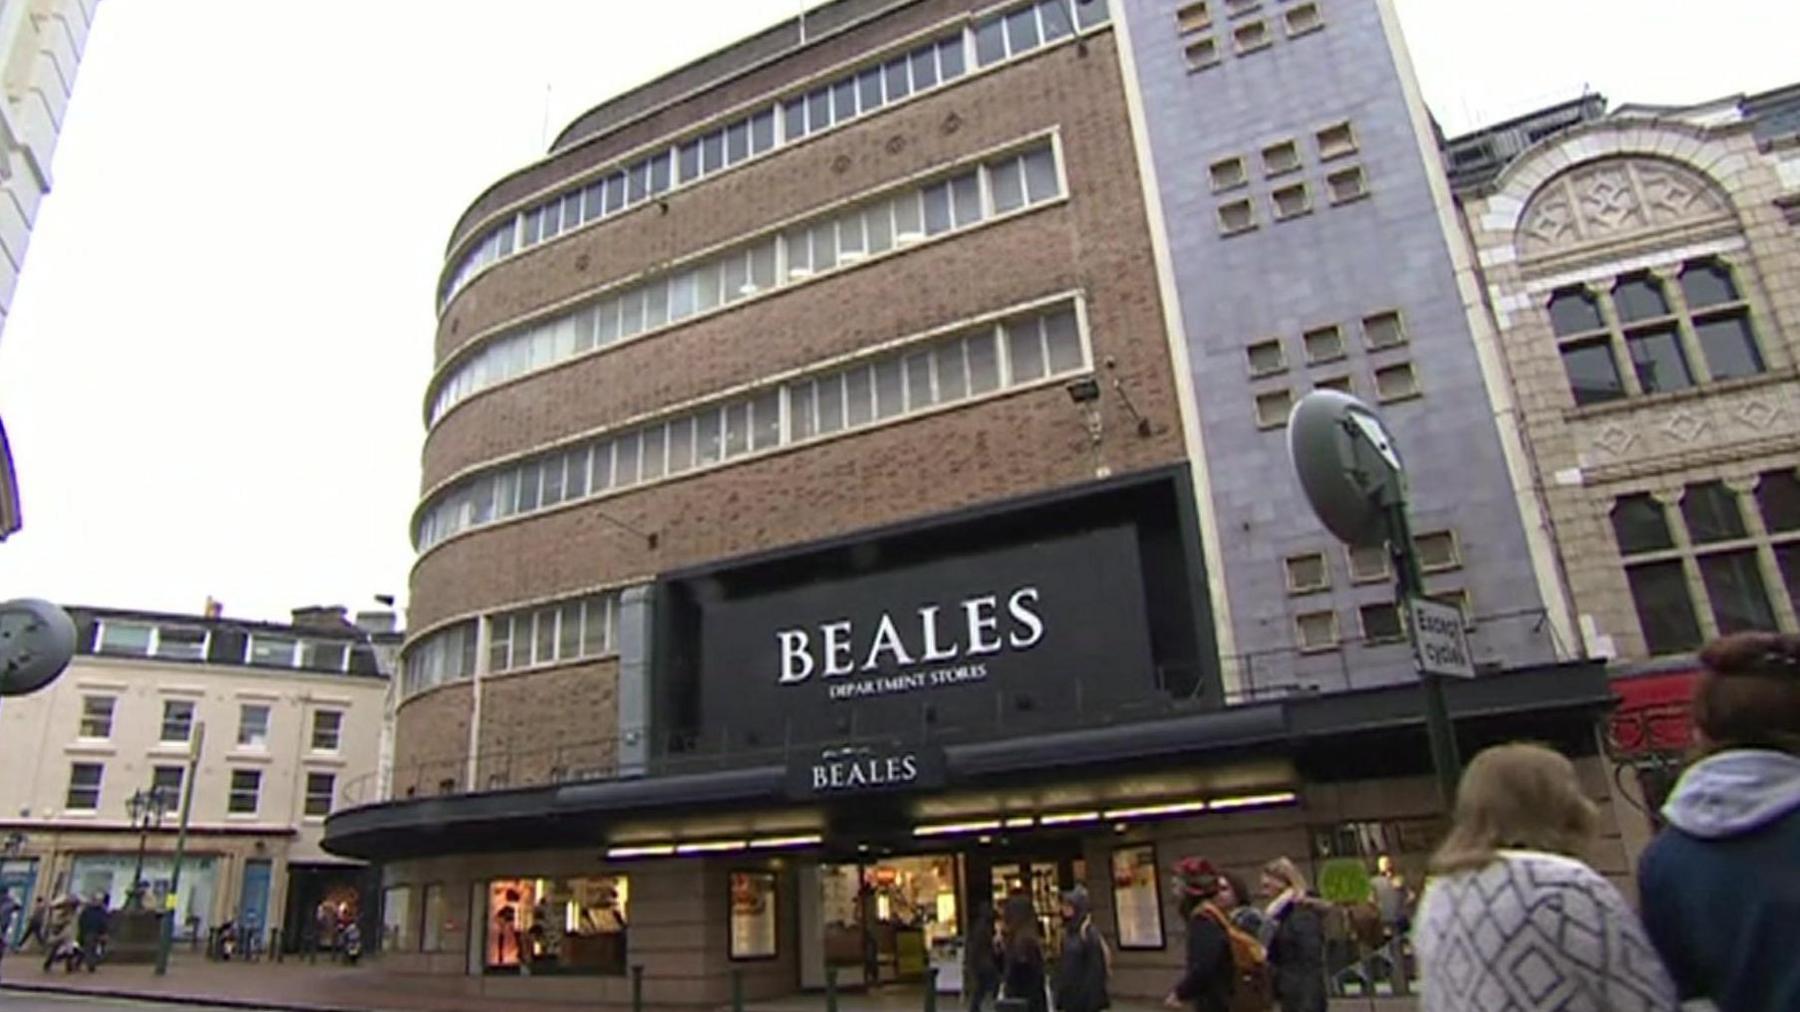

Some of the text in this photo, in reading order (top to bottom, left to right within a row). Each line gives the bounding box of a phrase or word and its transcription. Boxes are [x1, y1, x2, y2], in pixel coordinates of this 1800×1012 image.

[776, 587, 1044, 683] BEALES
[829, 663, 988, 699] DEPARTMENT STORES
[812, 755, 917, 789] BEALES
